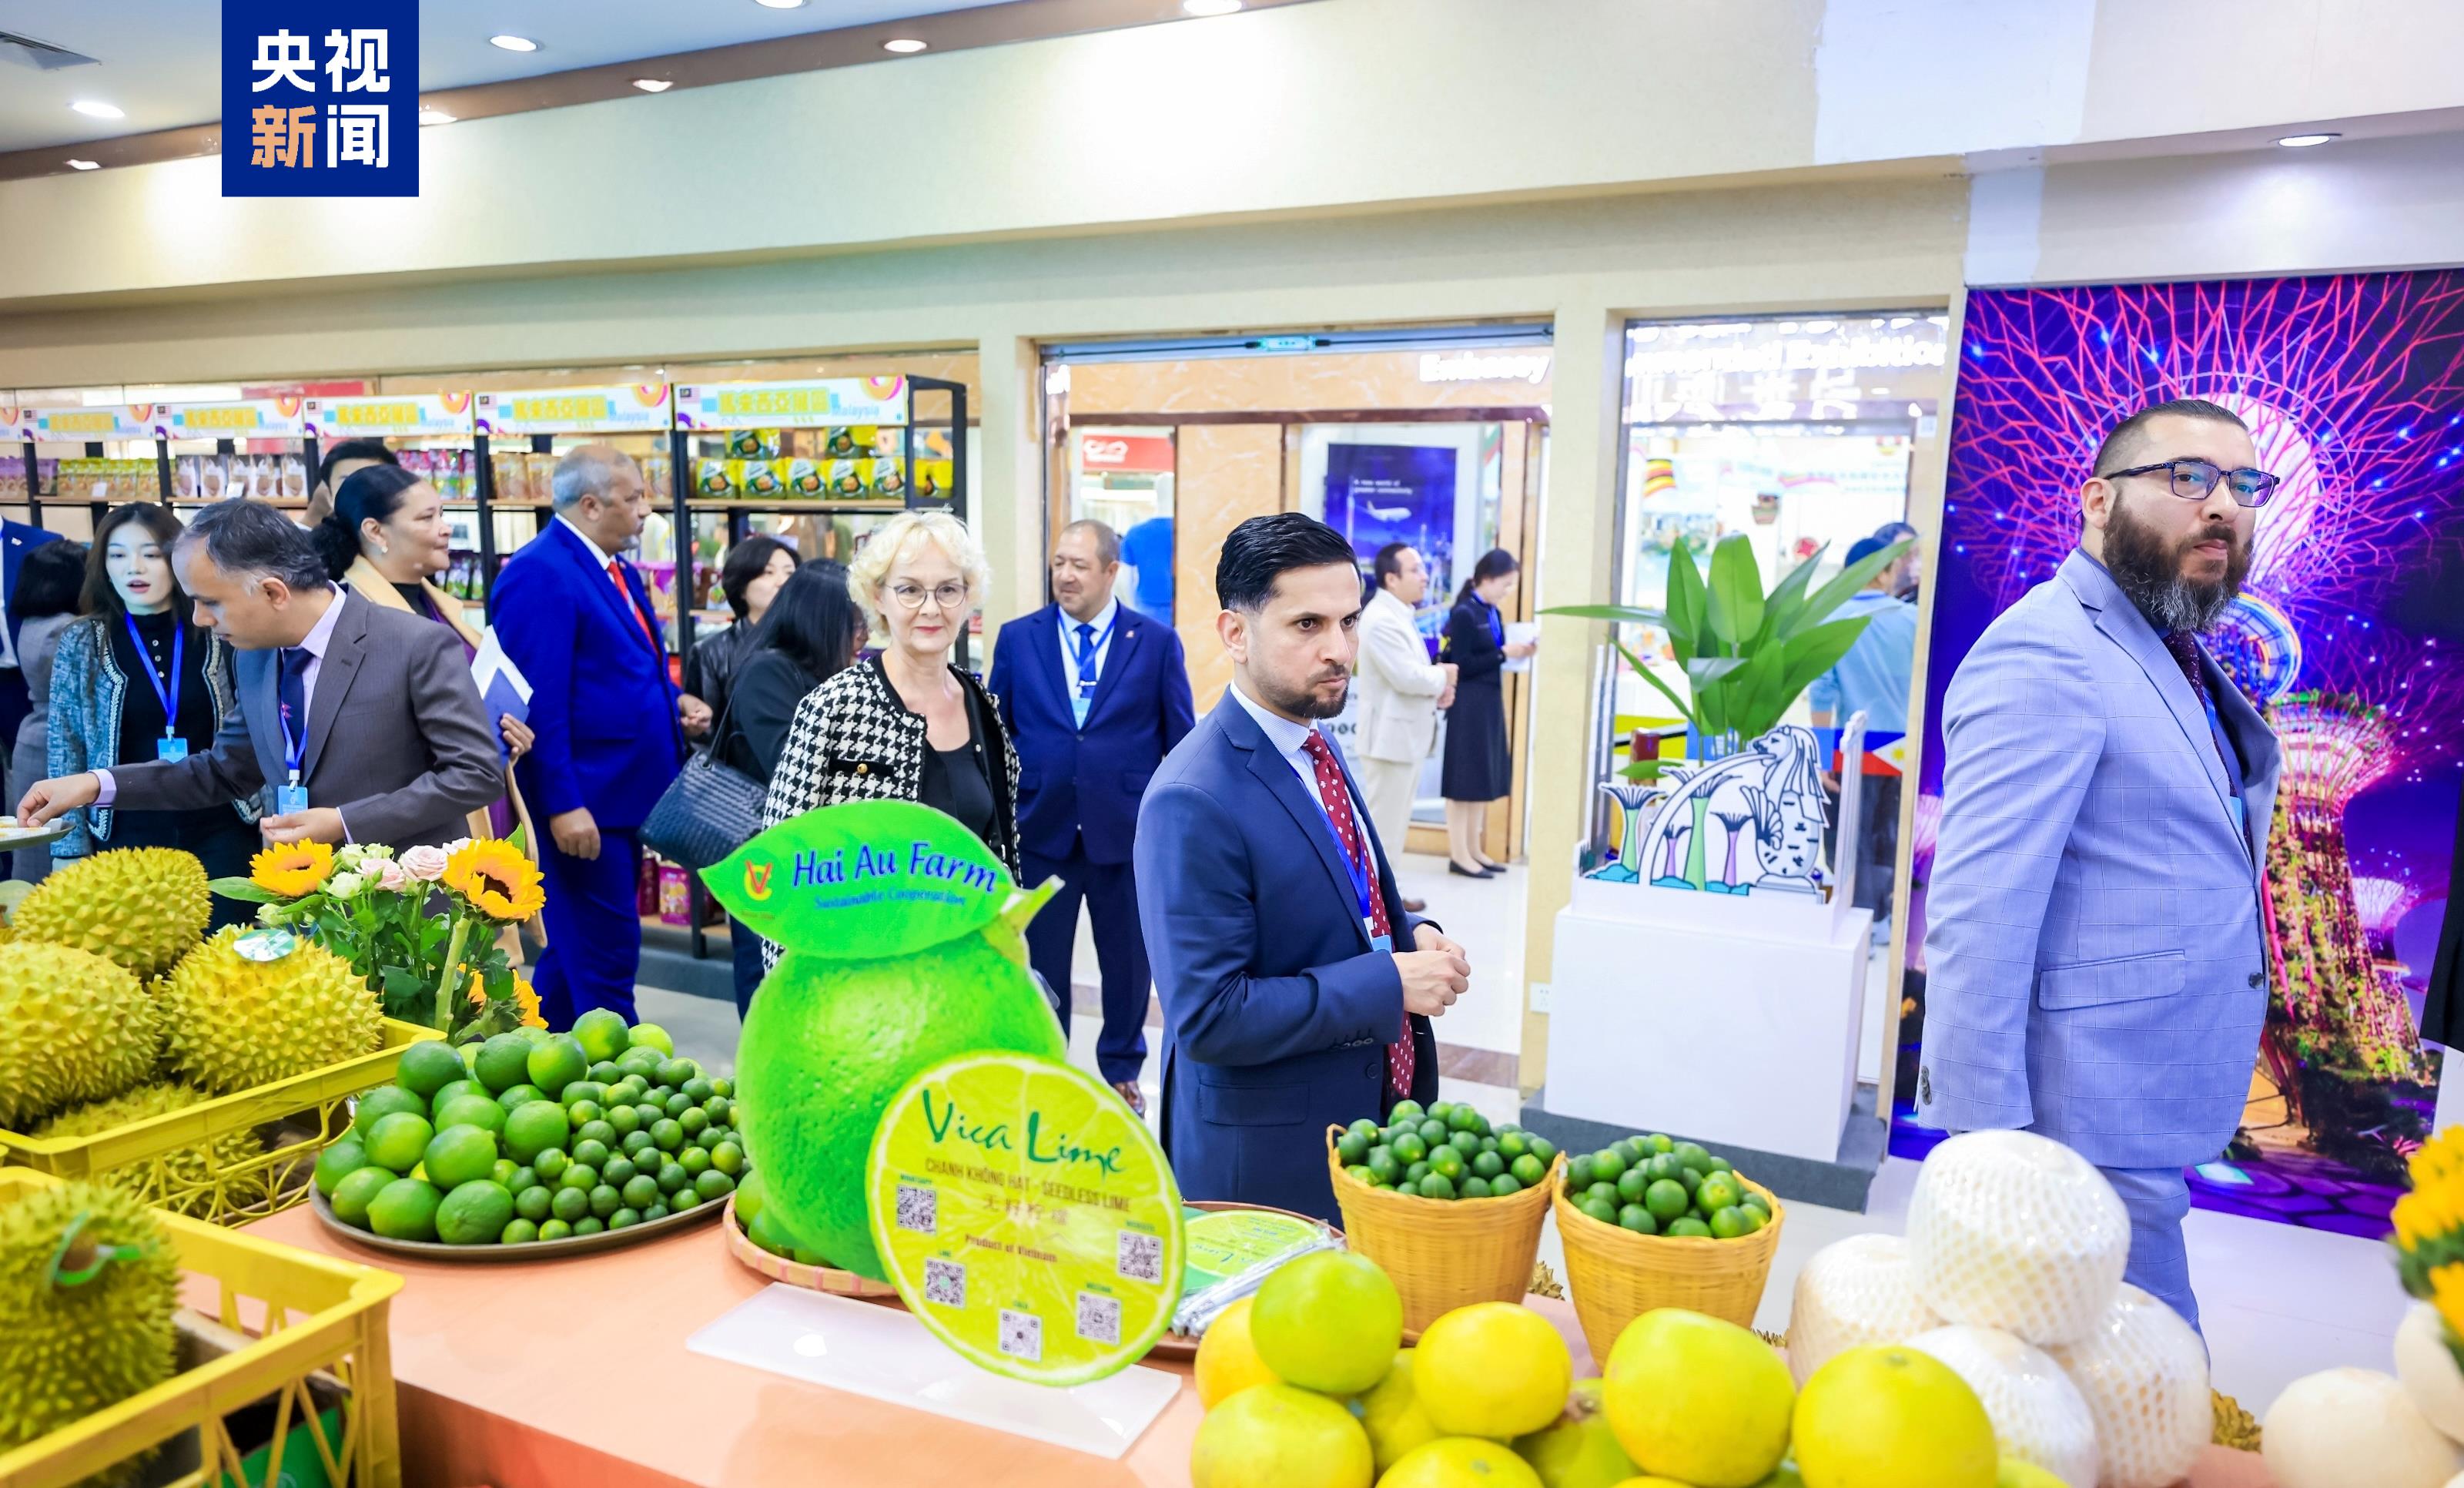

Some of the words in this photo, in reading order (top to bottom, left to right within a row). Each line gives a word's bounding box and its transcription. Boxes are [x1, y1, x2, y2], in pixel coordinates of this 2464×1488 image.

[832, 404, 879, 420] Malaysia
[793, 850, 845, 887] Hai
[855, 844, 896, 880] Au
[910, 841, 997, 893] Farm
[922, 1090, 1012, 1150] Vica
[1029, 1111, 1128, 1184] Lime
[1042, 1180, 1100, 1207] SEEDLESS
[1102, 1191, 1132, 1212] LIME
[965, 1233, 1003, 1251] Product
[1017, 1245, 1058, 1263] Vietnam
